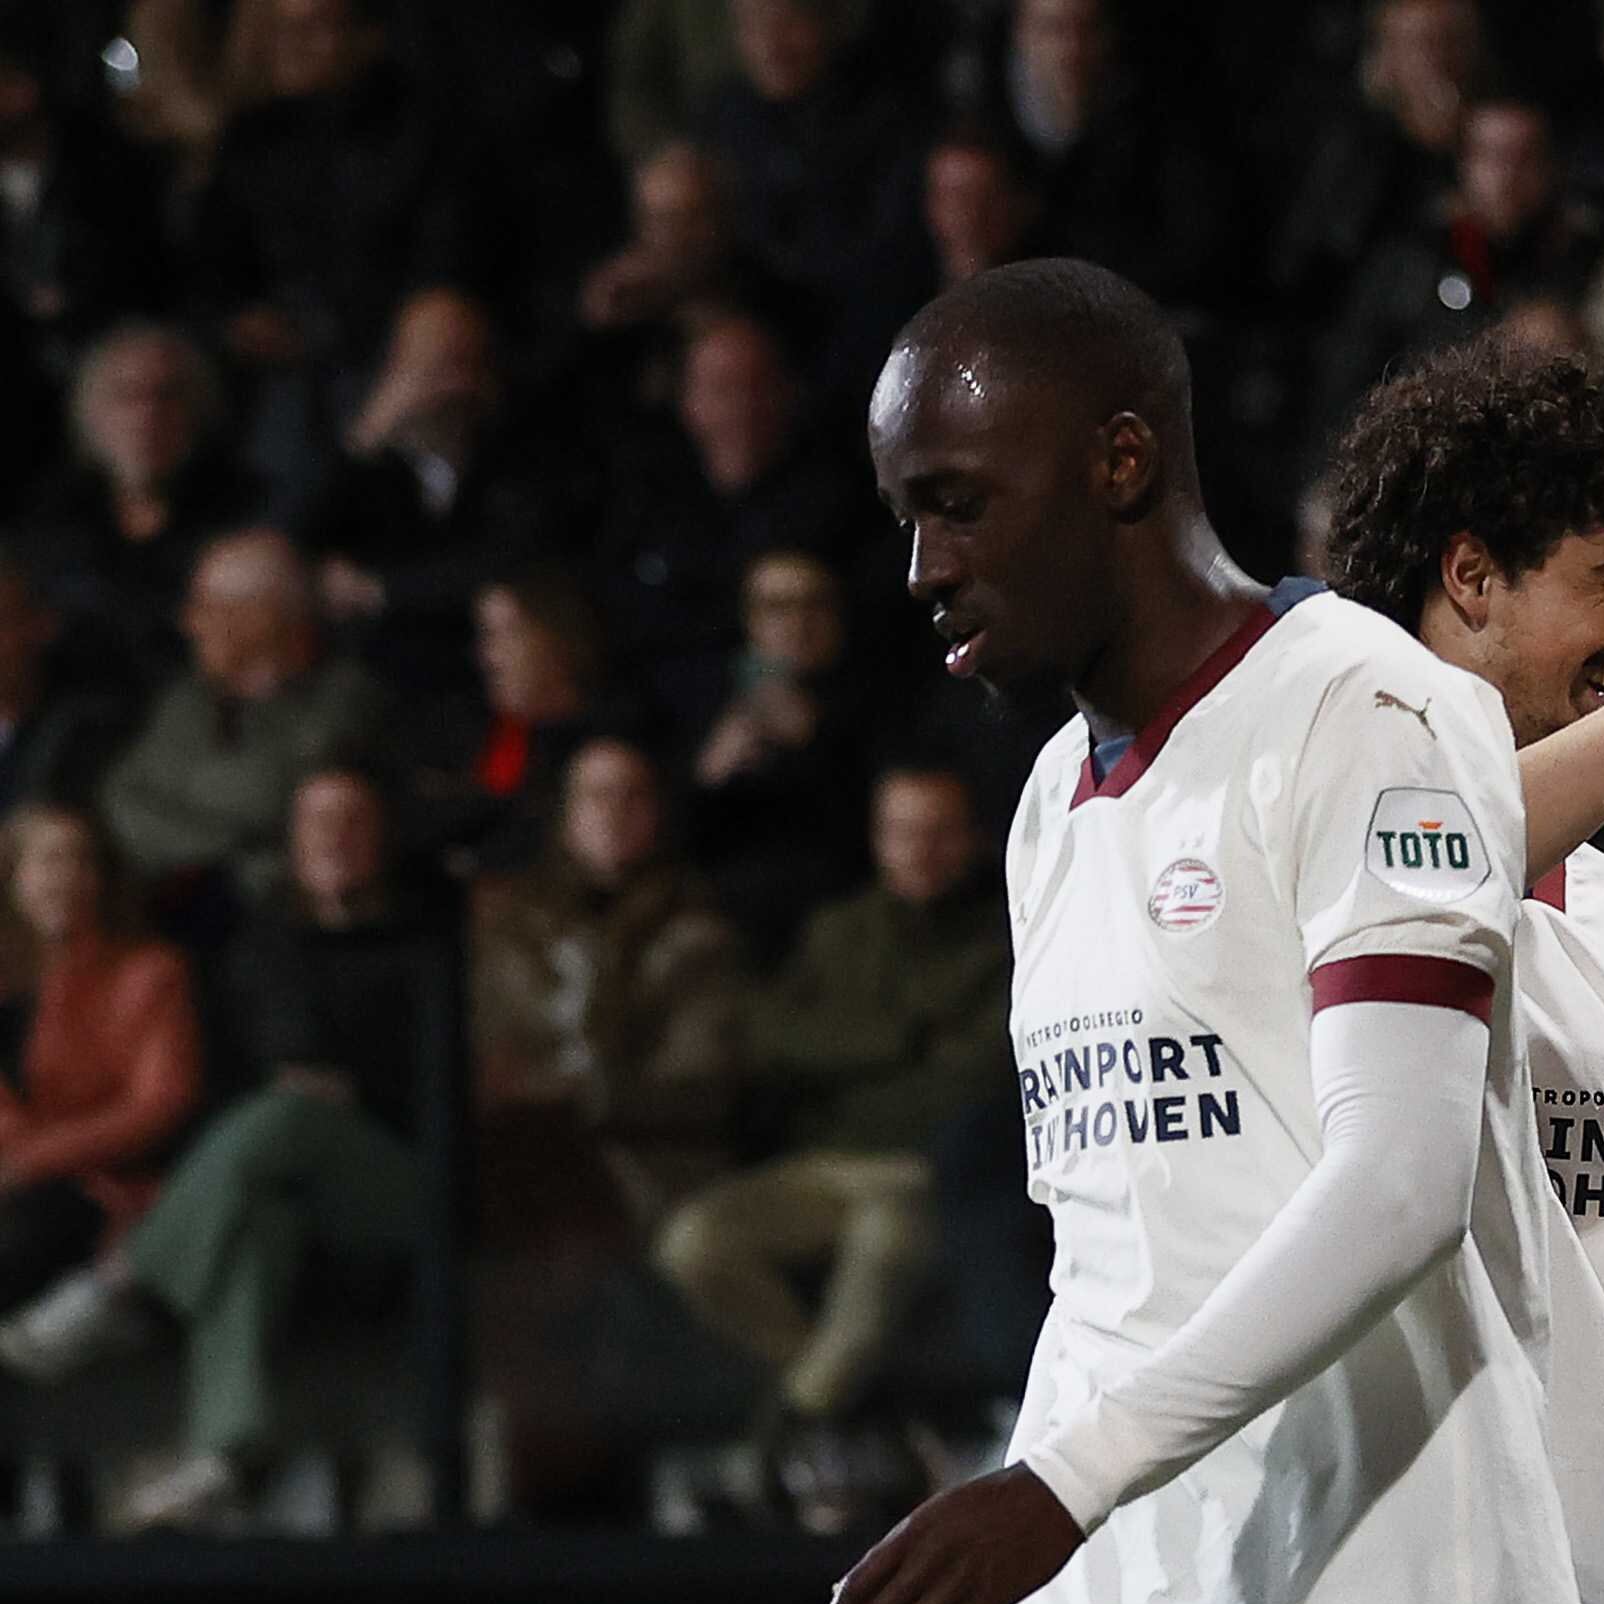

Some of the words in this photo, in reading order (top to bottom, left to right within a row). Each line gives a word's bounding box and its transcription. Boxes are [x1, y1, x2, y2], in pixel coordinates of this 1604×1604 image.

[1376, 830, 1470, 870] TOTO
[1025, 1008, 1144, 1050] ETROOOLREGIO
[1019, 1033, 1224, 1115] RANPORT
